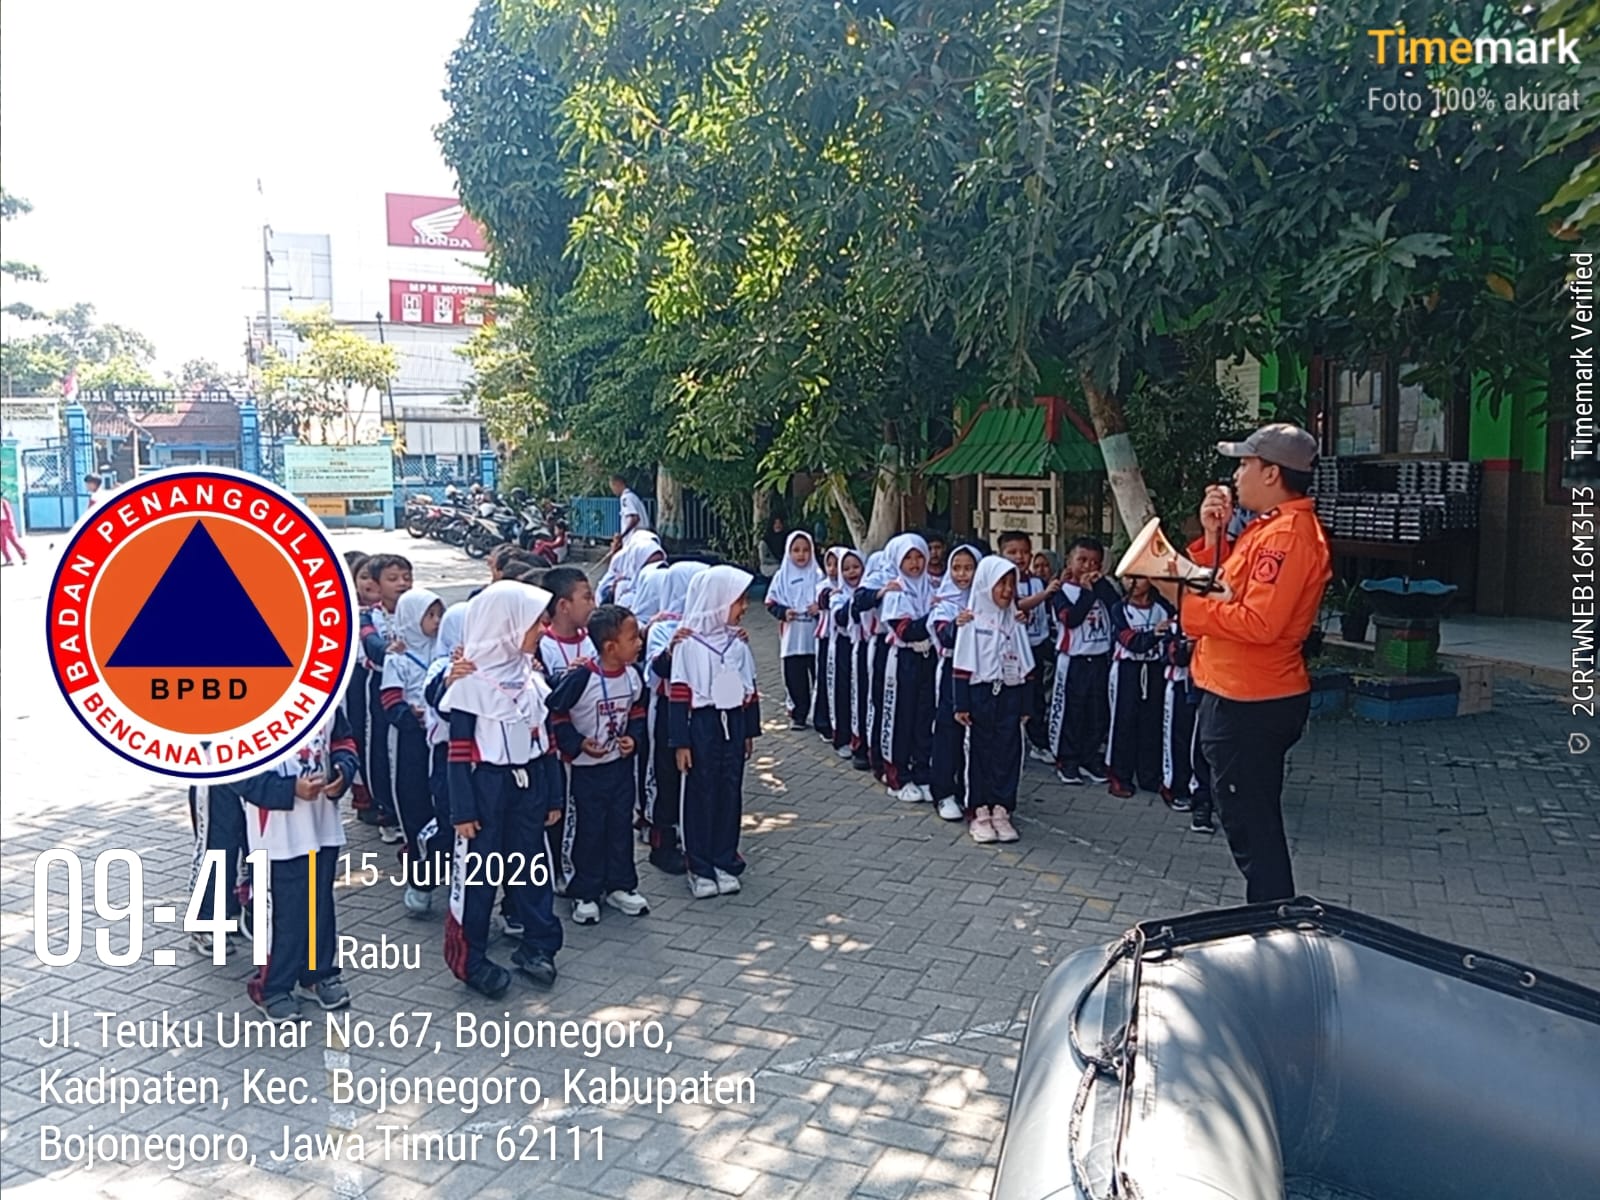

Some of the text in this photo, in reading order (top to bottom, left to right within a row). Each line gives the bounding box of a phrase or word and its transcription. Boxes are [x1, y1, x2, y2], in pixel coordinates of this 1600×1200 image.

[413, 234, 472, 249] HONDA
[408, 283, 478, 295] MPM MOTOR
